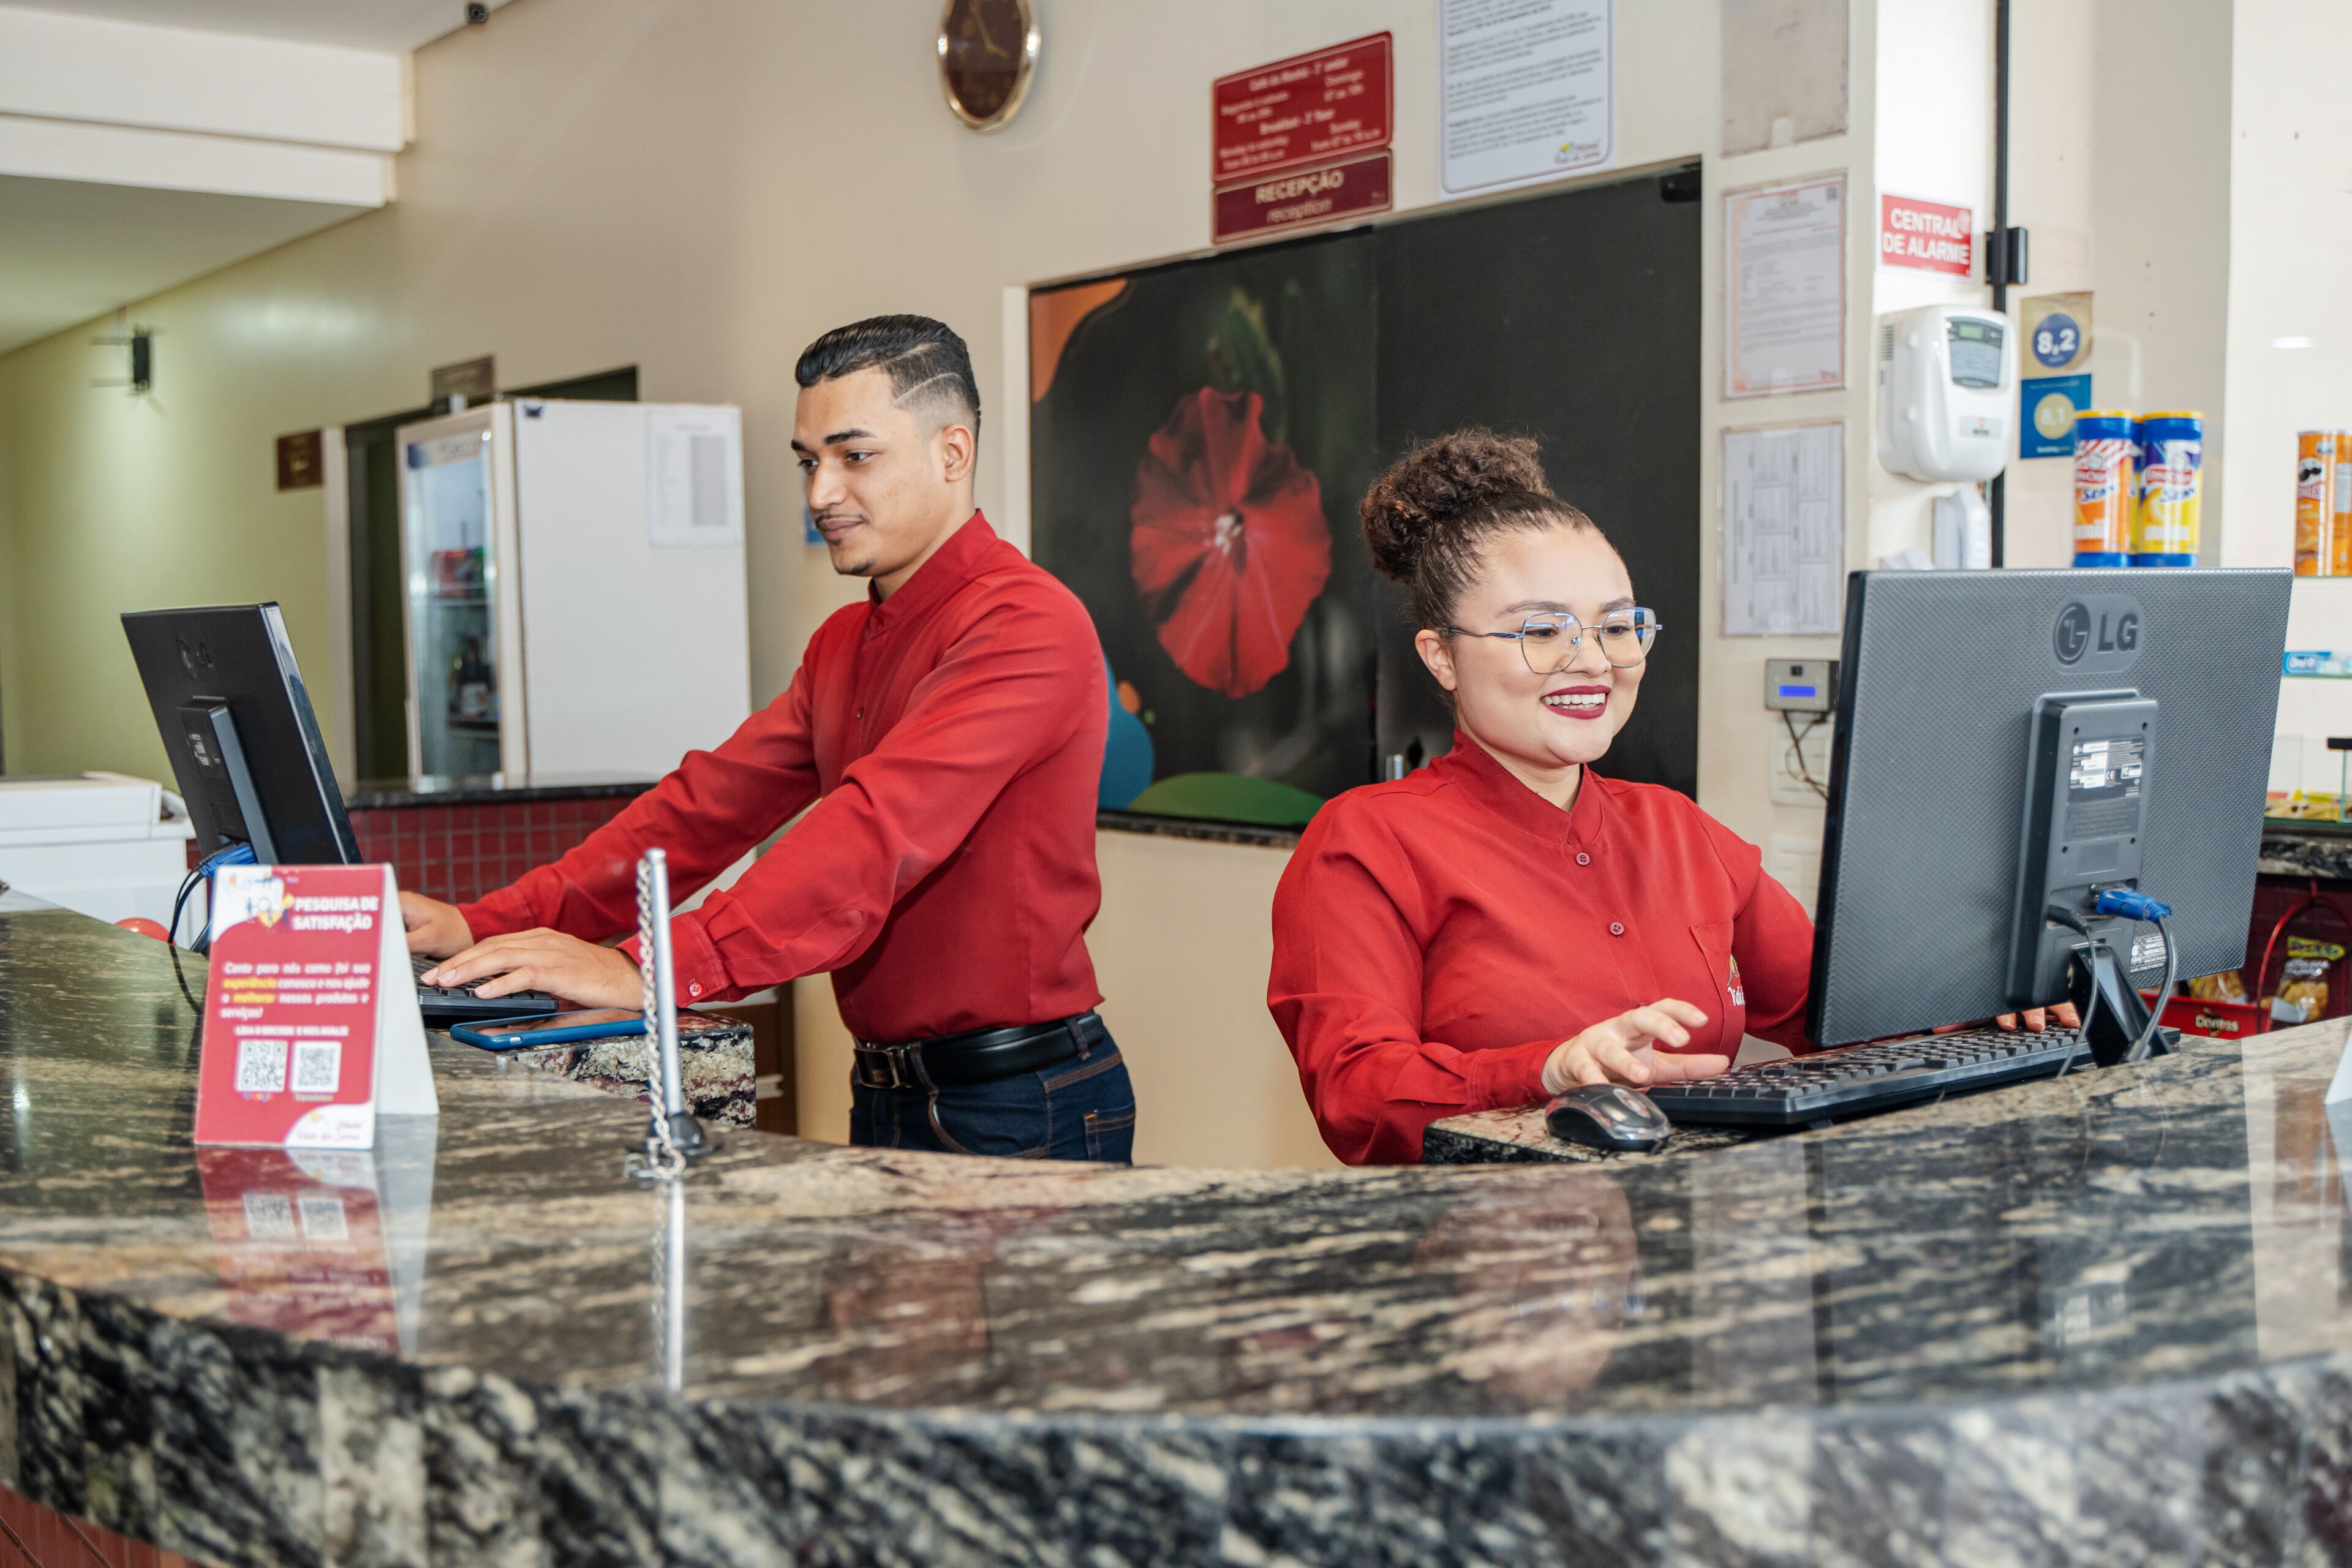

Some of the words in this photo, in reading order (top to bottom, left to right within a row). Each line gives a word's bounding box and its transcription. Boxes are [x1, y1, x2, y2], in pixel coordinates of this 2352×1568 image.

[1256, 170, 1344, 204] RECEPÇÃO
[1267, 198, 1333, 223] reception
[1891, 208, 1964, 239] CENTRAL
[1883, 232, 1905, 254] DE
[1907, 235, 1970, 265] ALARME
[2037, 328, 2075, 355] 8,2
[2098, 612, 2139, 653] LG
[295, 897, 358, 911] PESQUISA
[360, 895, 379, 911] DE
[293, 913, 372, 933] SATISFAÇÃO
[225, 962, 252, 974] Conte
[256, 963, 279, 975] para
[282, 962, 301, 974] nós
[304, 963, 331, 974] como
[335, 962, 350, 975] foi
[353, 963, 372, 974] sua
[277, 978, 316, 989] conosco
[317, 979, 324, 989] e
[325, 979, 342, 989] nos
[233, 992, 276, 1003] melhorar
[279, 993, 312, 1003] nossos
[315, 992, 358, 1005] produtos
[221, 1007, 264, 1020] serviços!
[2195, 1014, 2239, 1032] Doritos
